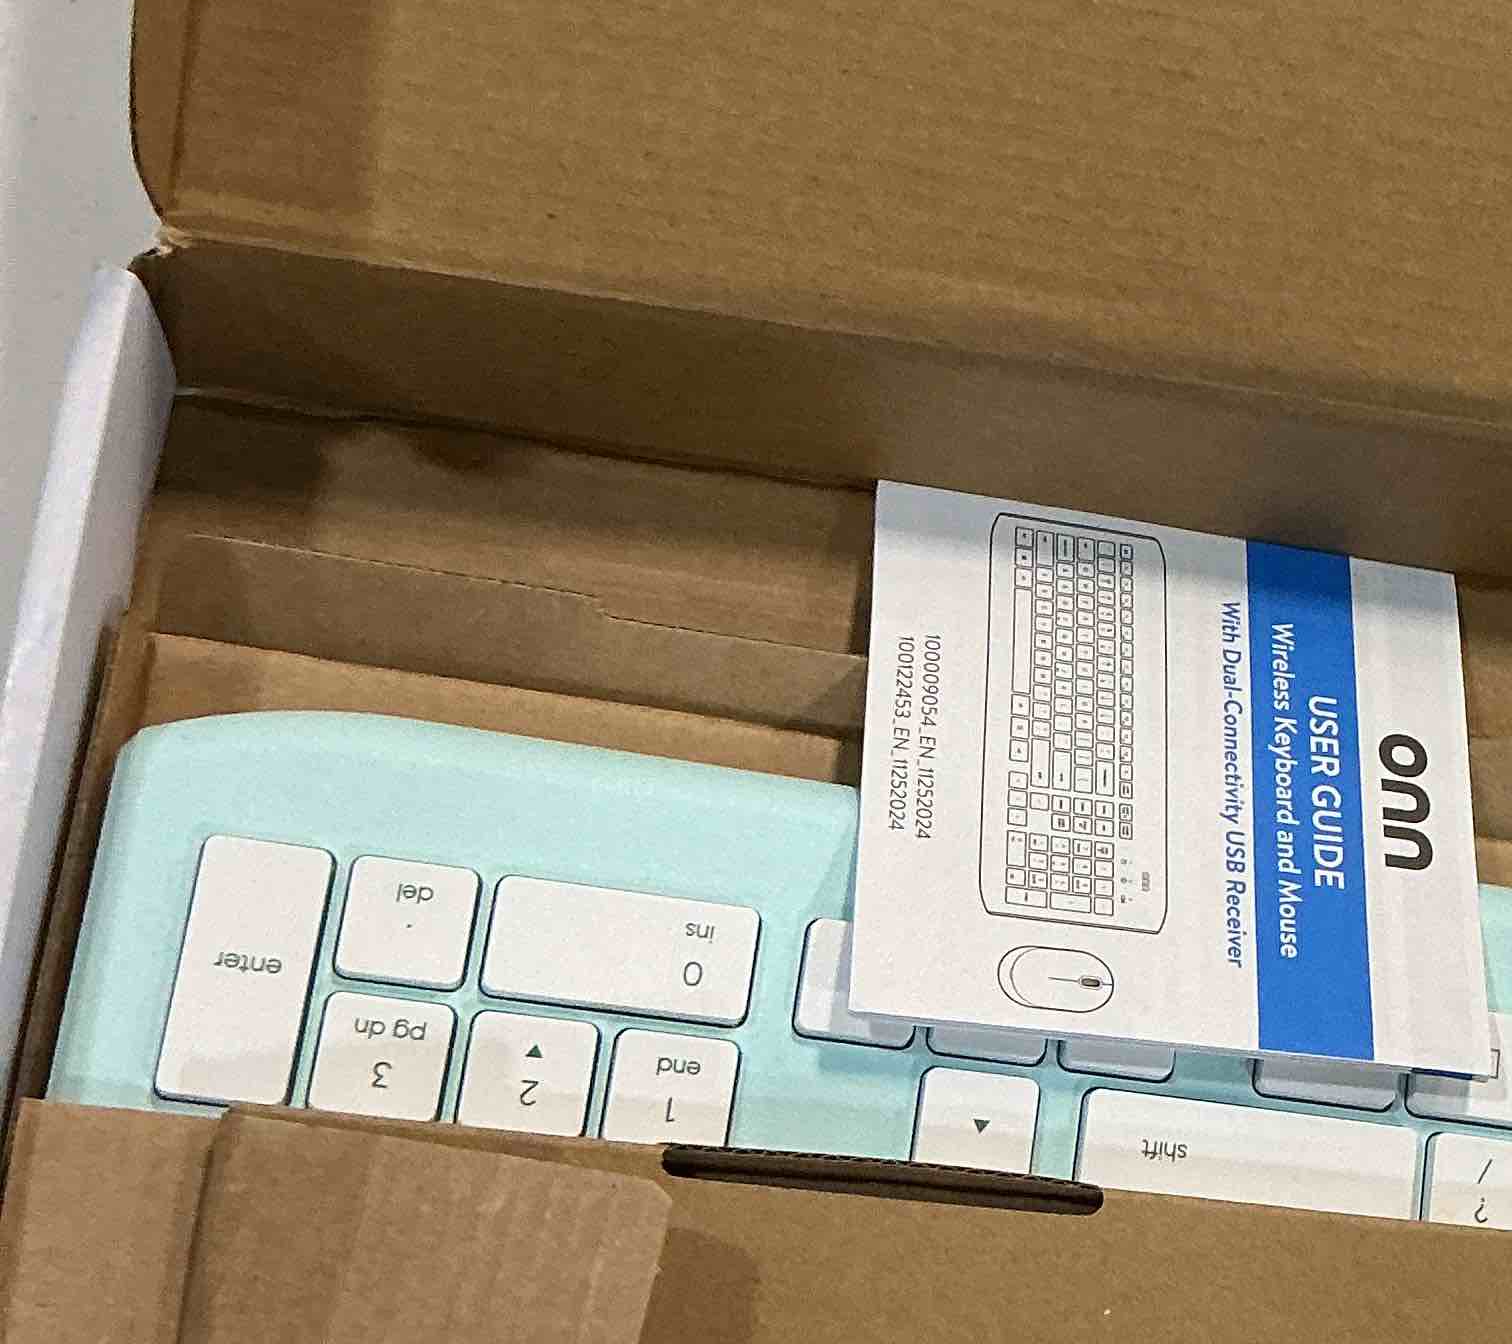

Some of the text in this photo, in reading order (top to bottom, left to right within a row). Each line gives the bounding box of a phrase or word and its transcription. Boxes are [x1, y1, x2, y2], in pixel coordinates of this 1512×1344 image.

[888, 636, 915, 831] 100122453_EN_11252024
[914, 635, 941, 839] 100009054_EN_11252024
[1219, 602, 1248, 969] With Dual-Connectivity USB Receiver
[1267, 623, 1303, 958] Wireless Keyboard and Mouse
[1308, 695, 1345, 890] USER GUIDE
[1378, 733, 1434, 871] onn
[396, 883, 434, 904] del
[685, 922, 715, 944] ins
[213, 951, 282, 974] enter
[683, 961, 703, 987] 0
[354, 1018, 427, 1041] pg dn
[371, 1061, 393, 1089] 3
[655, 1057, 701, 1076] end
[519, 1079, 539, 1106] 2
[1141, 1139, 1188, 1163] shift
[1474, 1197, 1489, 1224] ?
